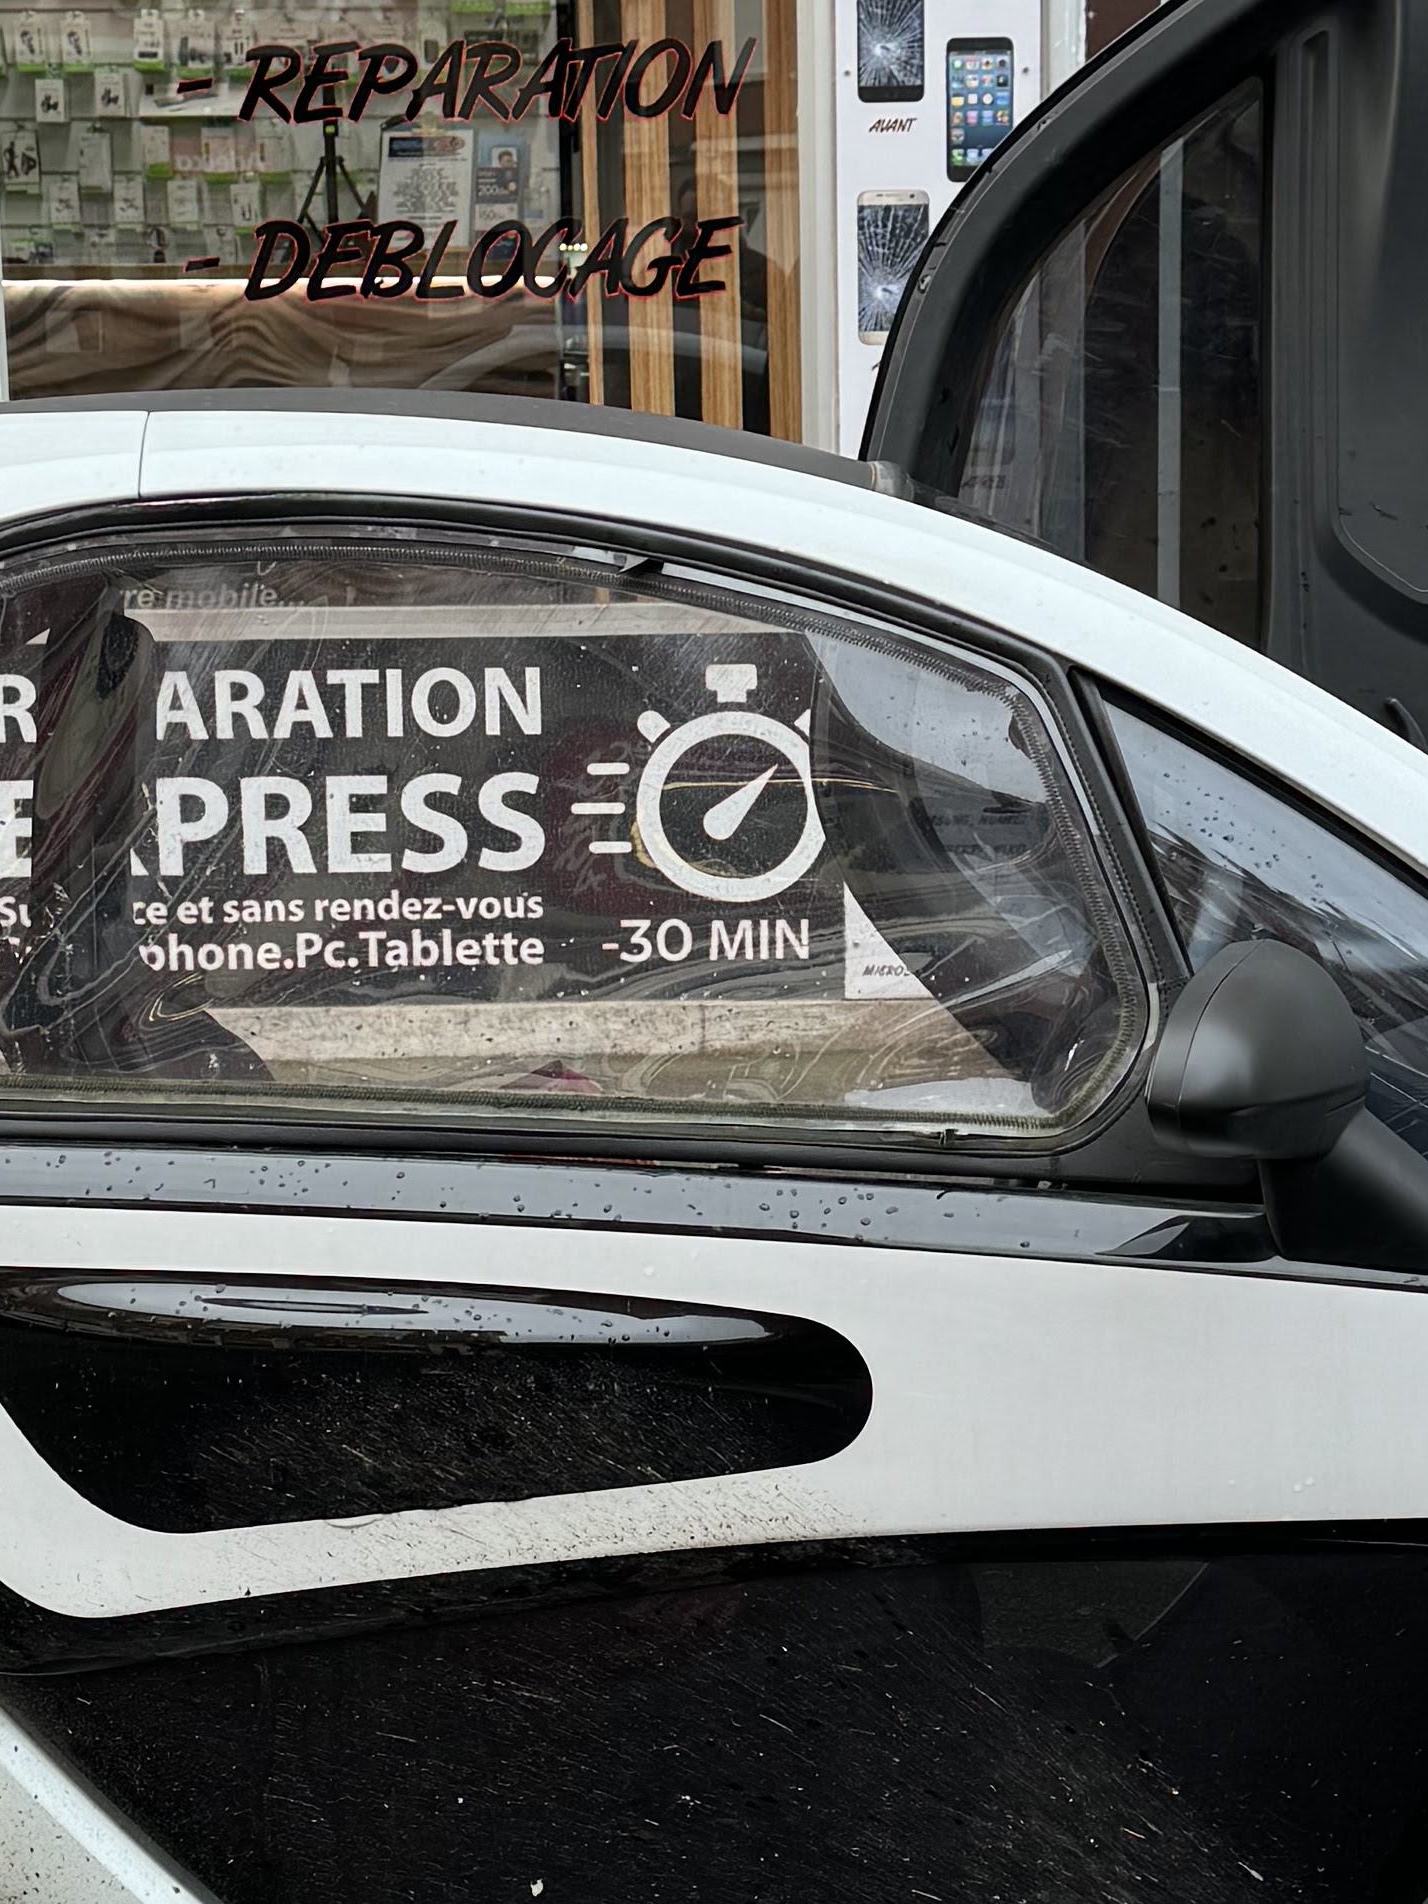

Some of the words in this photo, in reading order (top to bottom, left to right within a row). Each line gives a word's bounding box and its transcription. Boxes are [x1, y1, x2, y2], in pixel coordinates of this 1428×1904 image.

[238, 36, 757, 124] REPARATION
[869, 116, 917, 135] AVANT
[244, 215, 743, 303] DEBLOCAGE
[176, 896, 215, 925] et
[223, 898, 304, 924] sans
[315, 889, 544, 922] rendez-vous
[709, 918, 810, 961] MIN
